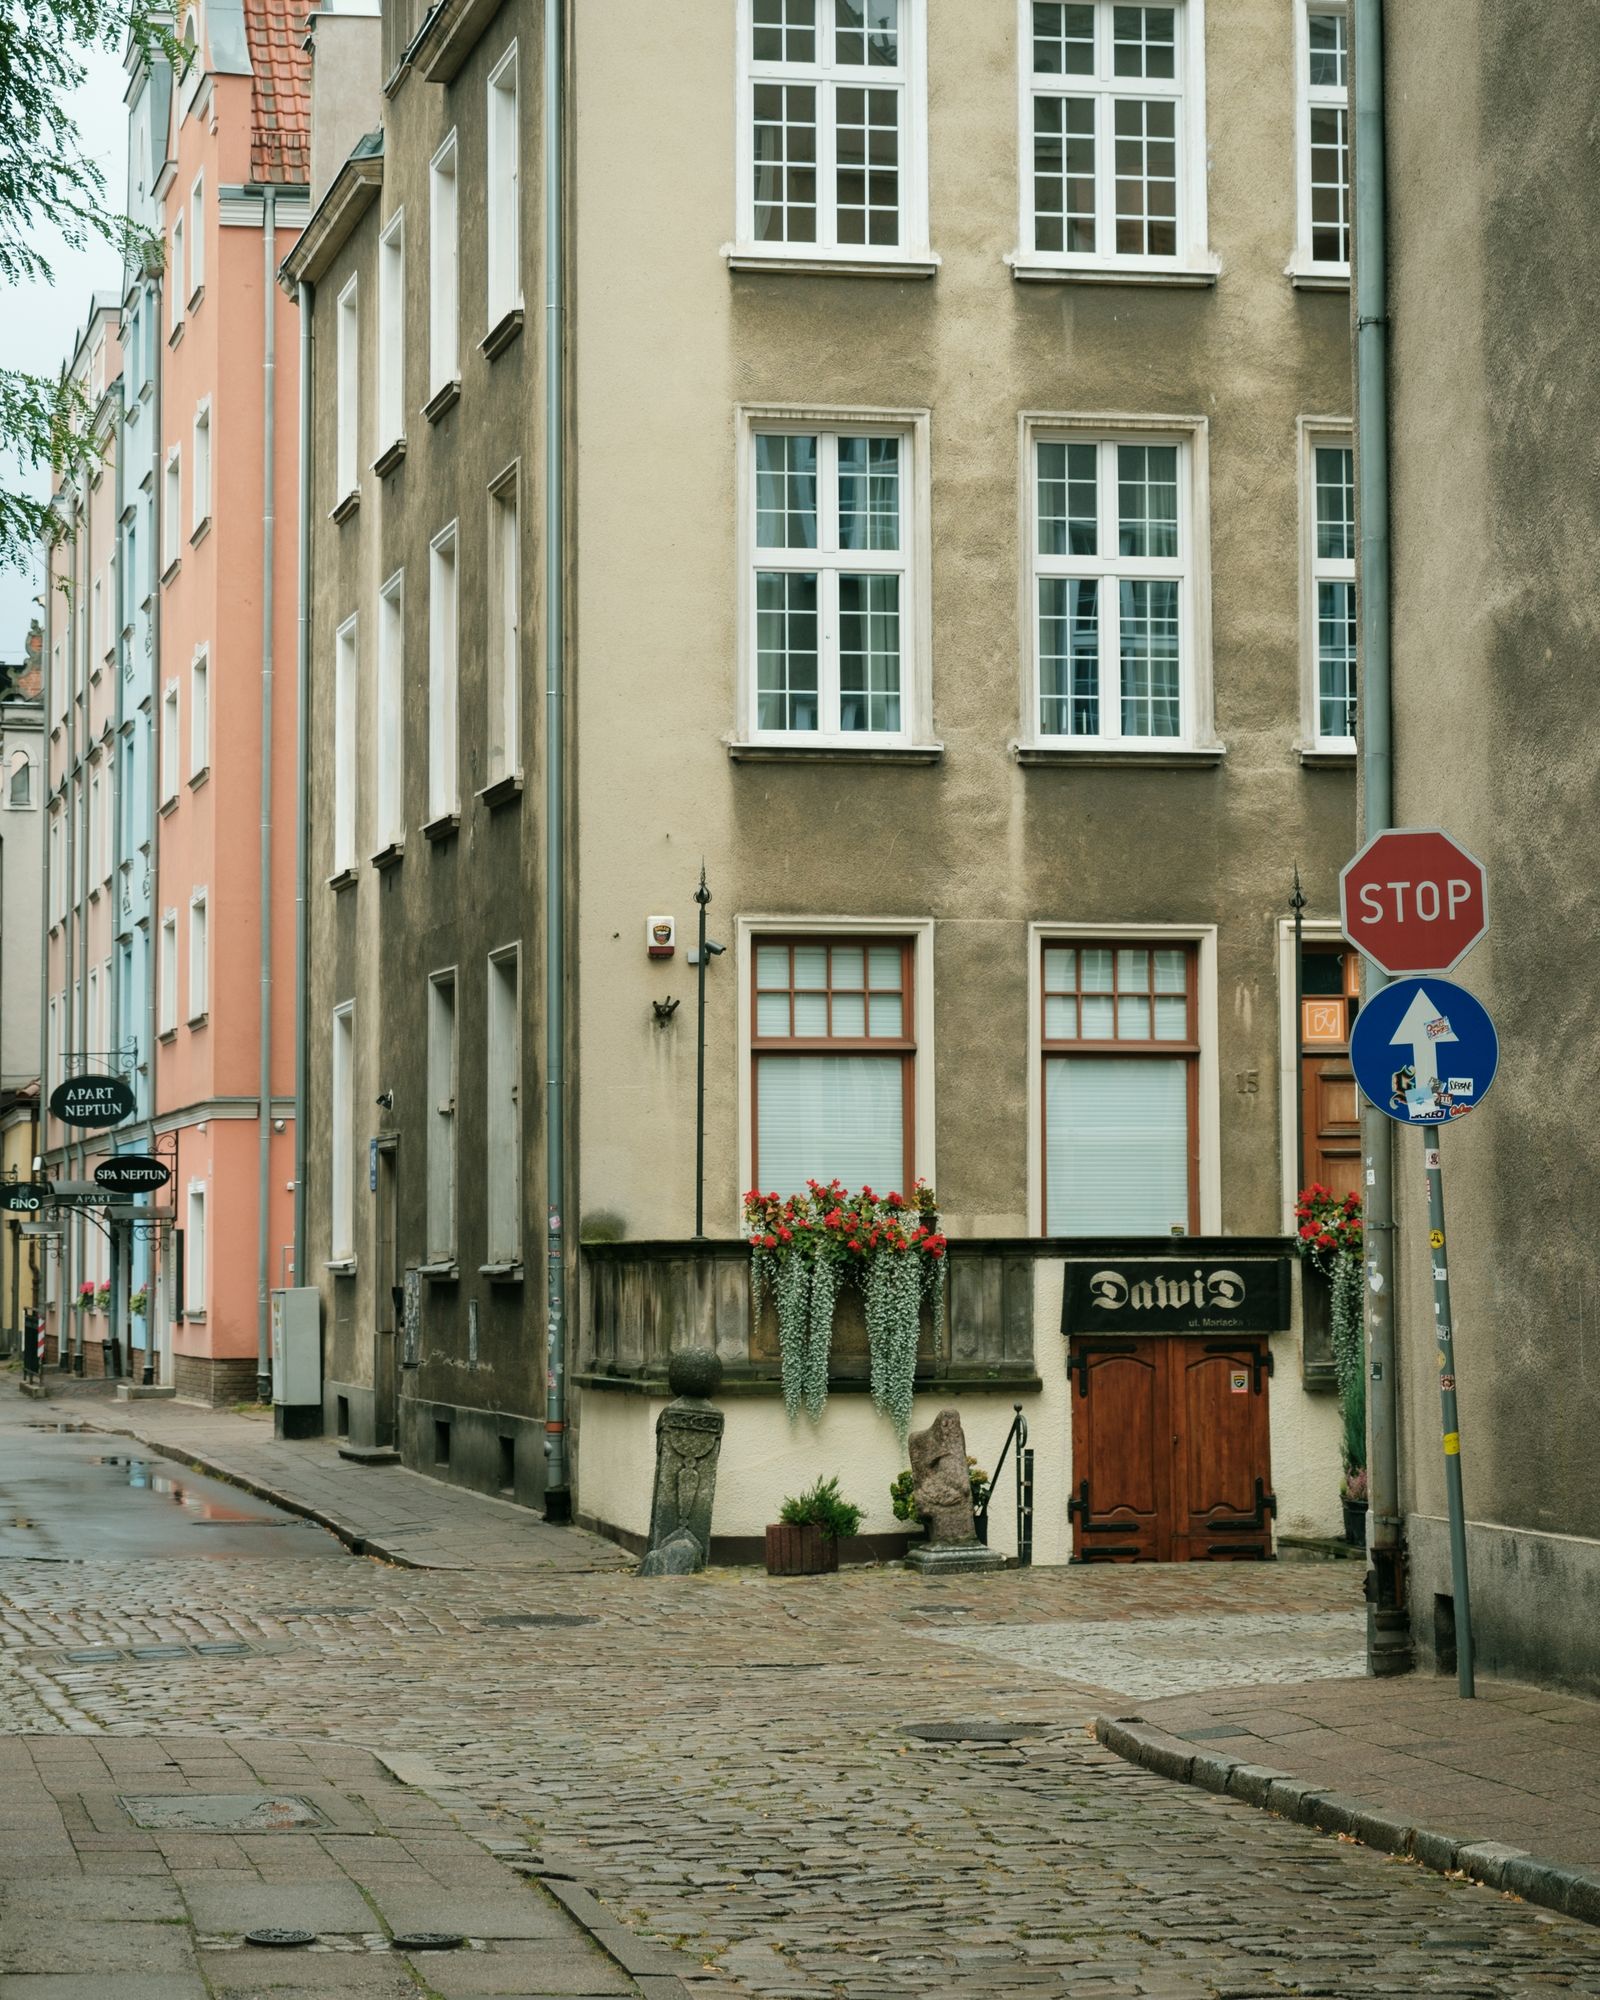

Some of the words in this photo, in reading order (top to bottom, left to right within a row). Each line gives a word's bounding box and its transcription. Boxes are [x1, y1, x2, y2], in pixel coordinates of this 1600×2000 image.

[1359, 879, 1471, 924] STOP
[1235, 1069, 1259, 1094] 15
[66, 1087, 114, 1101] APART
[65, 1103, 122, 1117] NEPTUN
[96, 1169, 117, 1180] SPA
[120, 1169, 167, 1181] NEPTUN
[10, 1198, 39, 1209] FINO
